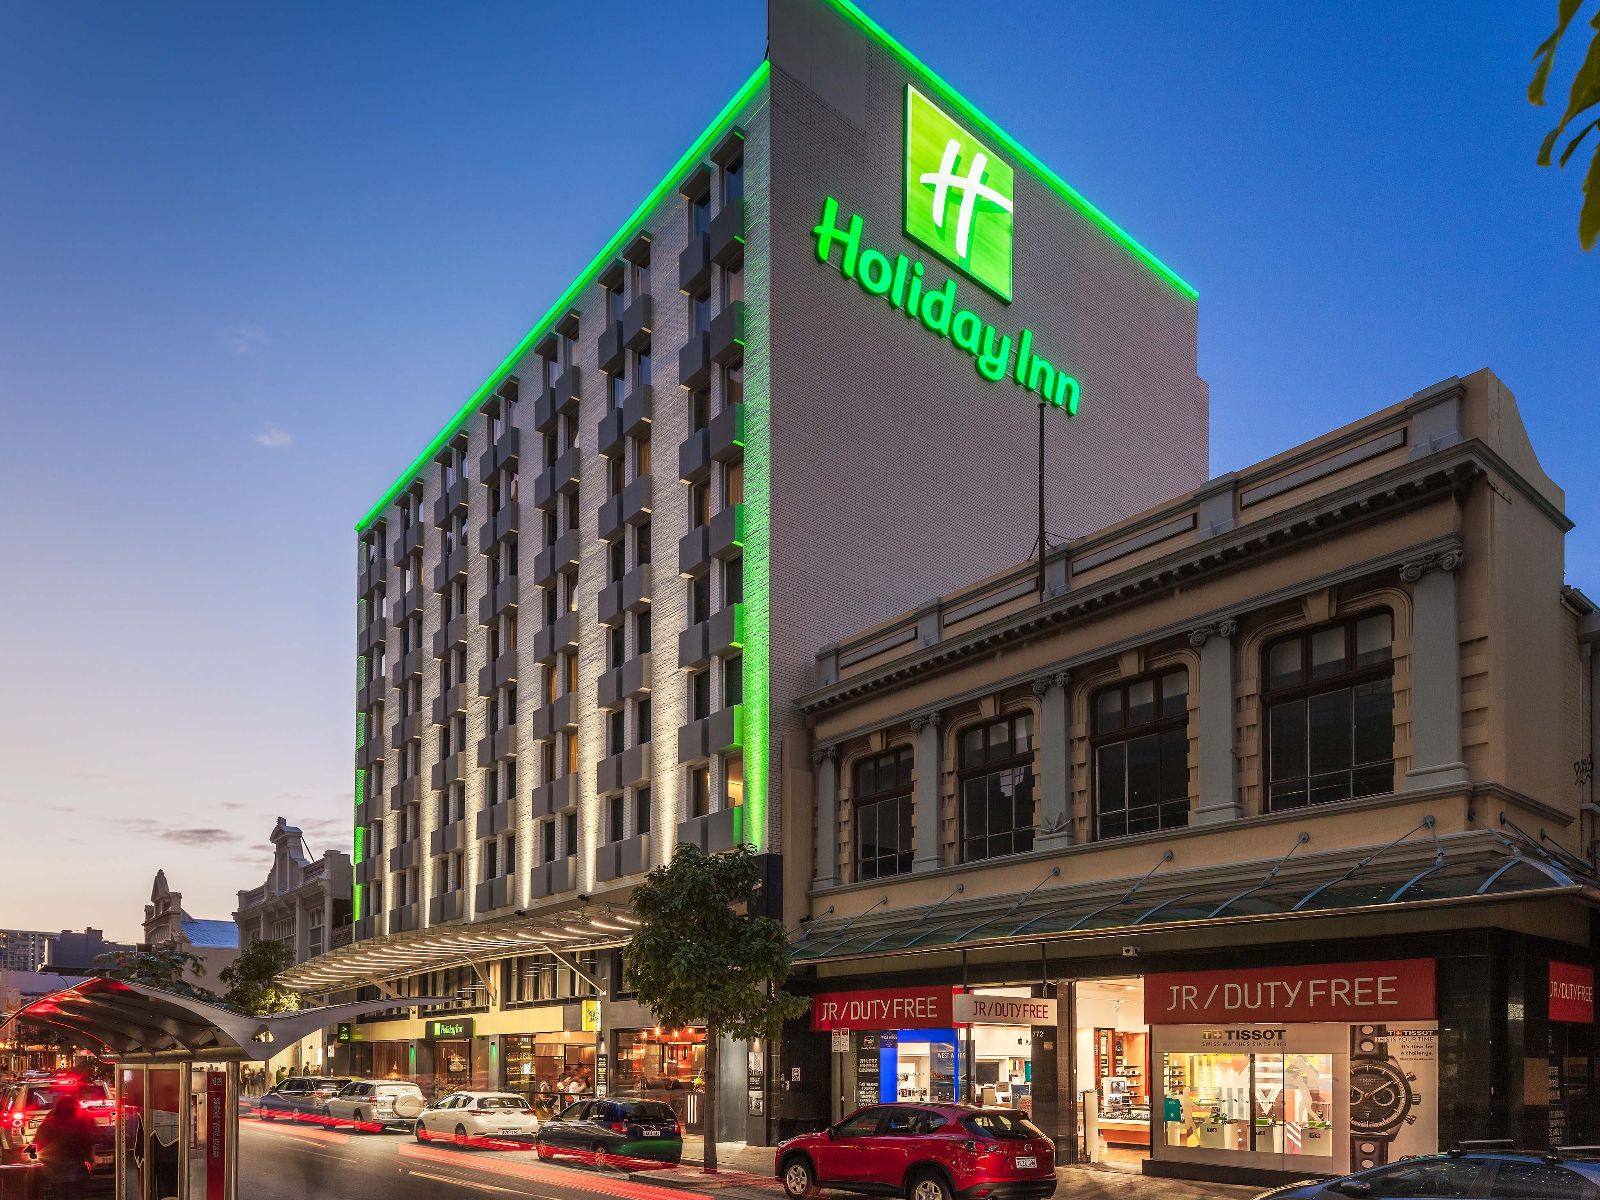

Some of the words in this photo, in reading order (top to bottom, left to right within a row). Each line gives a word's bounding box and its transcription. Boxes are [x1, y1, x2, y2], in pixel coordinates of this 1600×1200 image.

[811, 196, 1012, 382] Holiday
[1013, 328, 1082, 416] Inn
[1225, 1029, 1286, 1040] TISSOT
